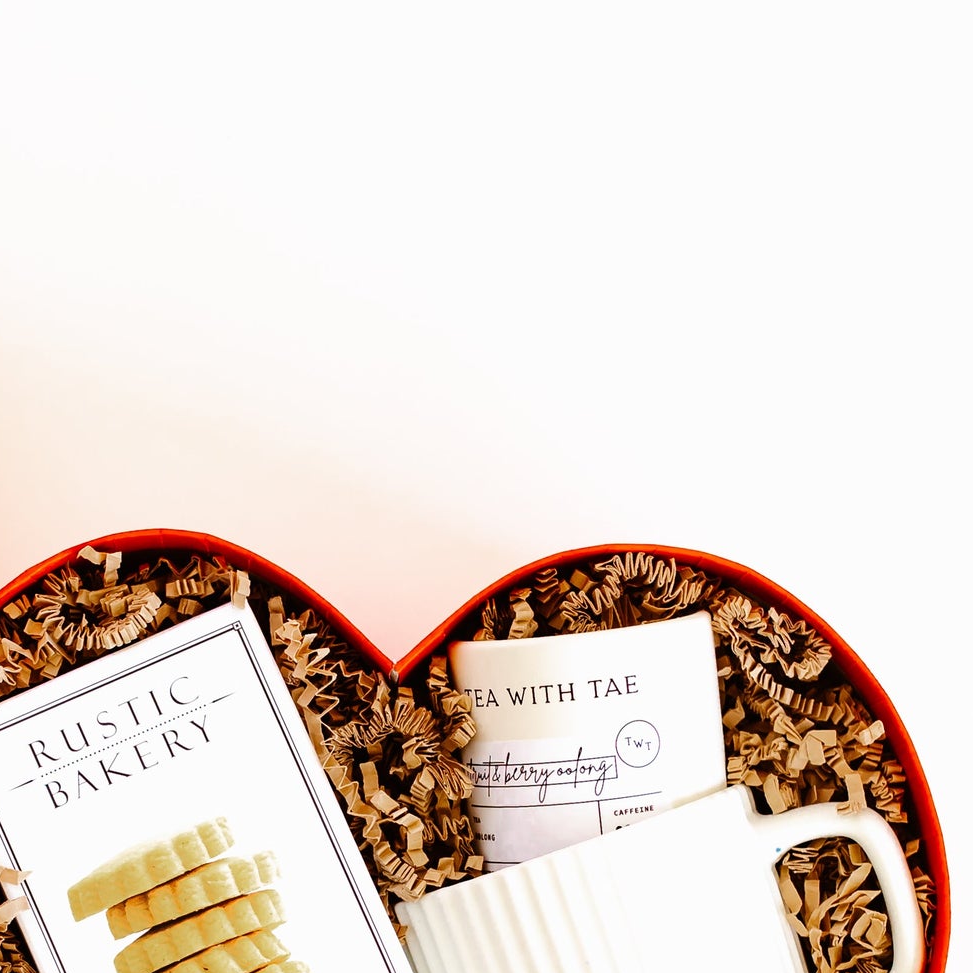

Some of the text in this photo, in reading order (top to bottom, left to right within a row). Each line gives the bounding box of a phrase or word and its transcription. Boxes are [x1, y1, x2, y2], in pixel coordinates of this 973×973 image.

[506, 682, 576, 706] WITH
[587, 675, 639, 699] TAE
[28, 677, 199, 768] RUSTIC
[44, 714, 211, 809] BAKERY
[625, 736, 652, 751] TWT
[556, 747, 613, 797] oolong
[613, 805, 655, 817] CAFFEINE
